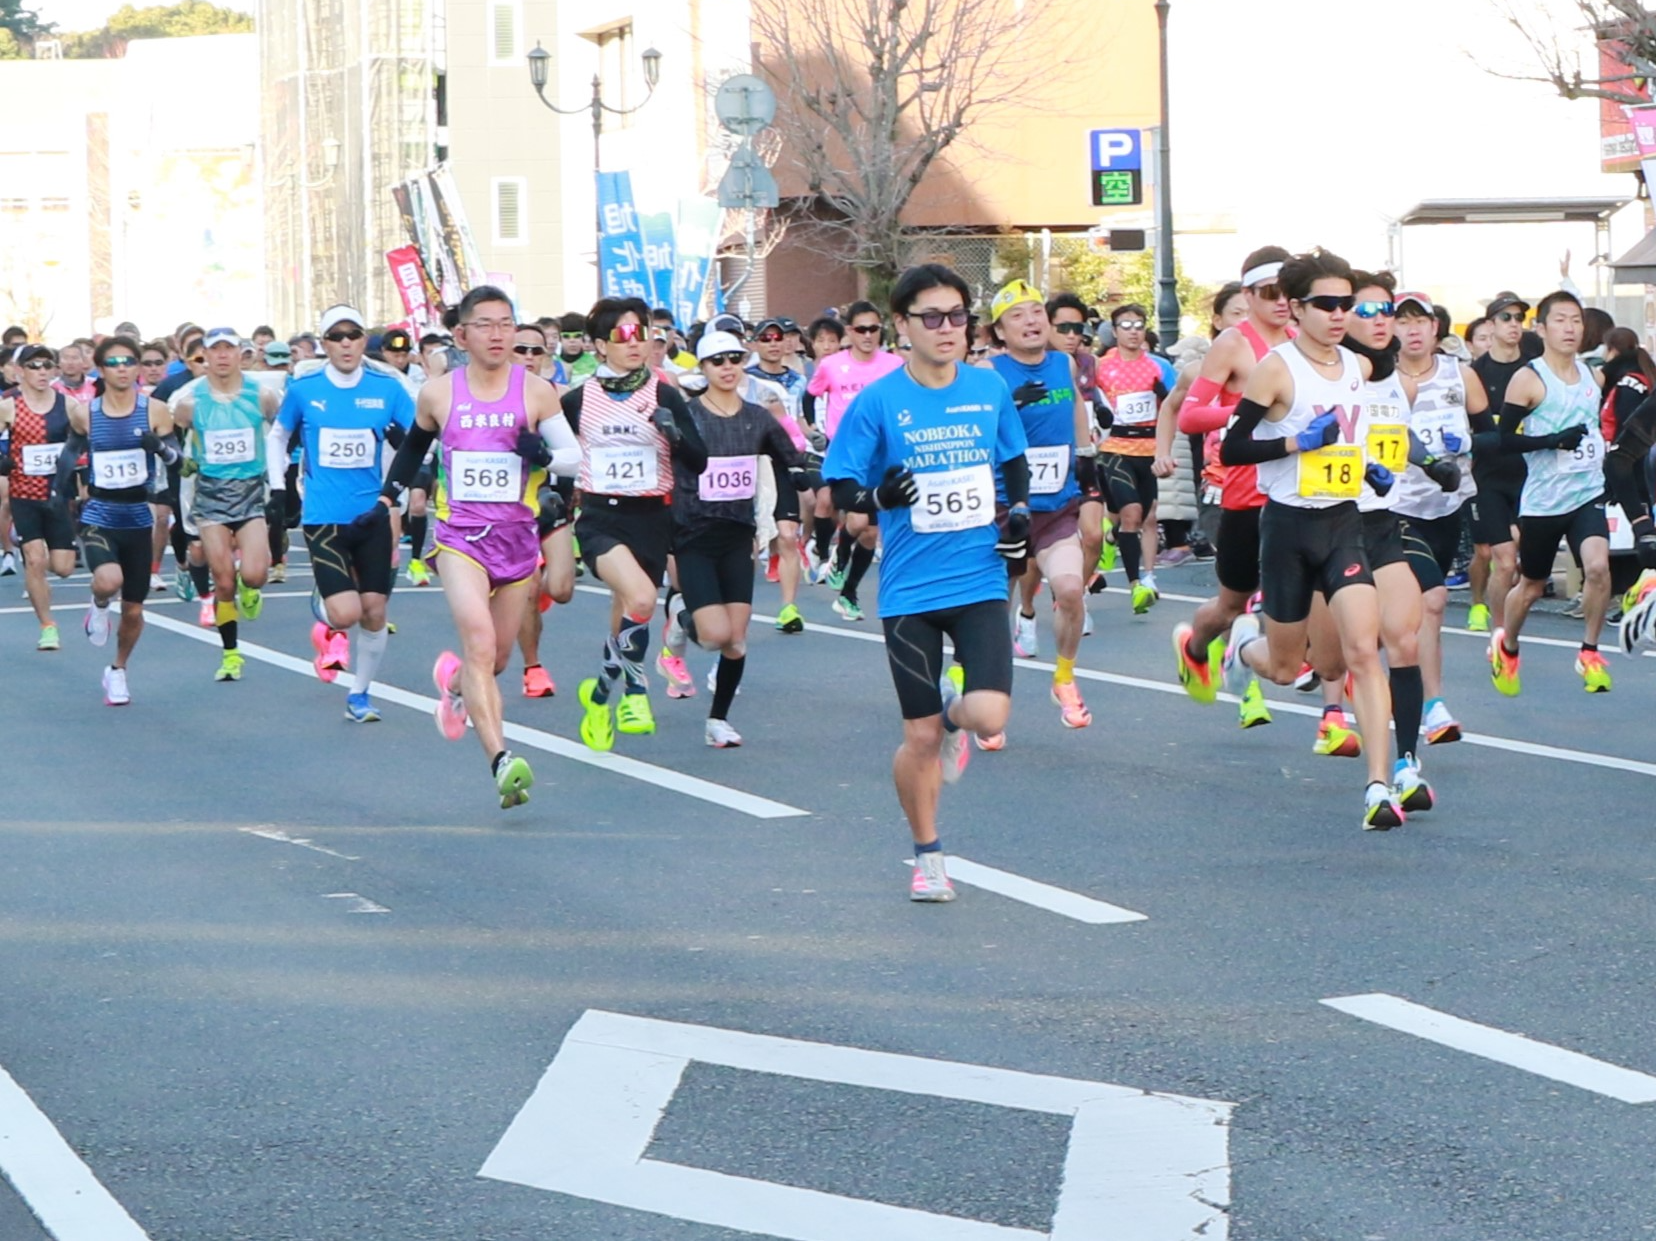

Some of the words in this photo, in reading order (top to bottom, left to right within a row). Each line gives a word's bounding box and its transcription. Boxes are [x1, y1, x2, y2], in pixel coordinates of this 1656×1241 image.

[1099, 133, 1133, 167] P
[1101, 171, 1134, 204] 空
[1126, 401, 1151, 415] 337
[461, 412, 514, 428] 西米良村
[904, 424, 982, 445] NOBEOKA
[213, 440, 247, 456] 293
[330, 442, 367, 457] 250
[914, 439, 975, 454] NISHINIPPON
[1376, 440, 1399, 460] 17
[902, 448, 991, 469] MARATHON
[103, 462, 139, 478] 313
[463, 469, 509, 487] 568
[605, 461, 645, 479] 421
[1323, 463, 1351, 484] 18
[707, 470, 752, 489] 1036
[927, 488, 981, 515] 565
